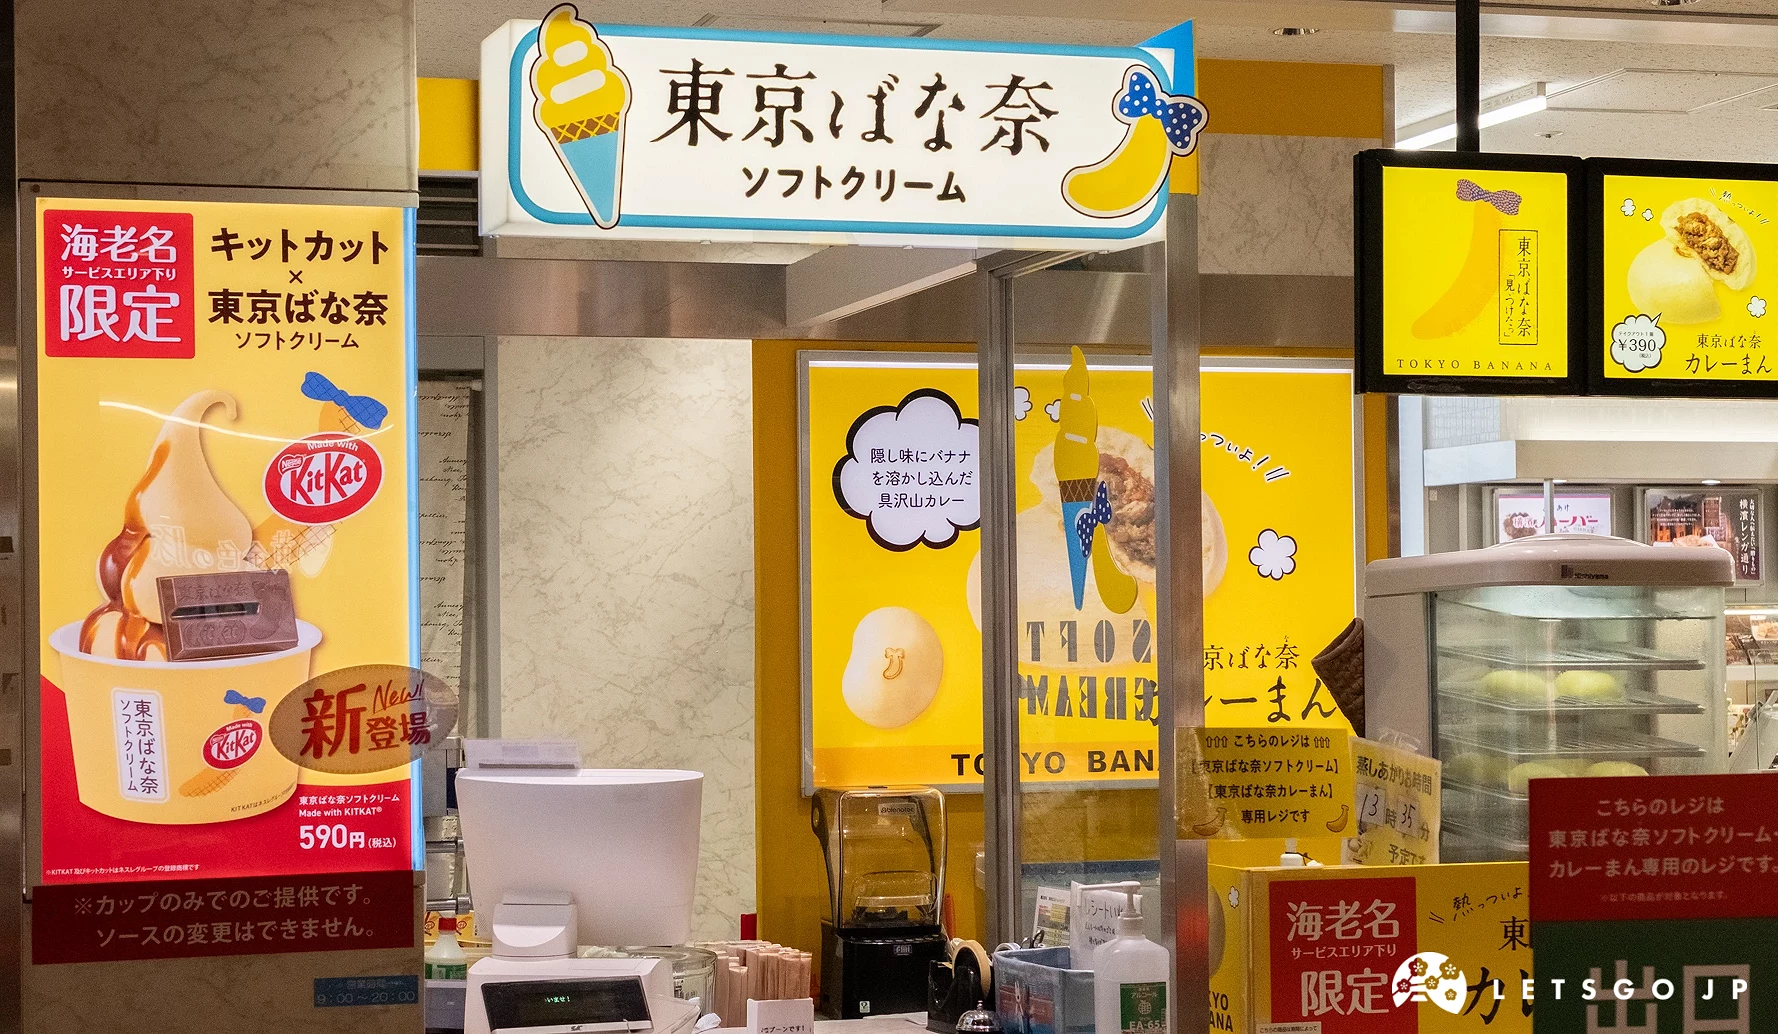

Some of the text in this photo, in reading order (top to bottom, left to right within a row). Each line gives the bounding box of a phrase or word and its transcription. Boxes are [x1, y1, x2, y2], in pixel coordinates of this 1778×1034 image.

[650, 58, 1060, 157] 東京ばな奈
[743, 166, 966, 204] ソフトクリーム
[60, 223, 177, 264] 海老名
[210, 227, 389, 265] キットカット
[62, 266, 176, 281] サービスエリア下り
[1517, 236, 1532, 337] 東京ばな奈
[60, 284, 181, 343] 限定
[208, 289, 389, 326] 東京ばな奈
[235, 331, 360, 351] ソフトクリーム
[1618, 338, 1656, 352] ¥390
[1697, 333, 1762, 349] 東京ばな奈
[1396, 358, 1553, 372] TOKYO BANANA
[1685, 352, 1773, 375] カレーまん
[336, 440, 359, 452] with
[870, 447, 972, 465] 隠し味にバナナ
[290, 452, 364, 504] KitKat
[871, 470, 973, 487] を溶かし込んだ
[878, 491, 965, 509] 具沢山カレー
[121, 700, 138, 792] ソフトクリーム
[134, 700, 159, 794] 東京ばな奈
[217, 730, 254, 760] KitKat
[1234, 734, 1310, 748] こちらのレジは
[1088, 750, 1159, 773] BAN
[299, 794, 400, 806] 東京ばな奈ソフトクリーム
[1208, 783, 1334, 799] 【東京ばな奈カレーまん】
[299, 808, 322, 817] Made
[324, 807, 342, 816] with
[1241, 809, 1310, 824] 専用レジです
[1358, 794, 1379, 835] 13
[1401, 804, 1416, 829] 35
[1597, 797, 1725, 817] こちらのレジは
[299, 824, 396, 850] 590円 (税込)
[97, 916, 375, 947] ソースの変更はできません。
[1286, 899, 1400, 941] 海老名
[1498, 915, 1530, 951] 東
[1291, 944, 1397, 959] サービスエリア下り
[1301, 967, 1389, 1017] 限定
[1586, 960, 1750, 1034] 出口
